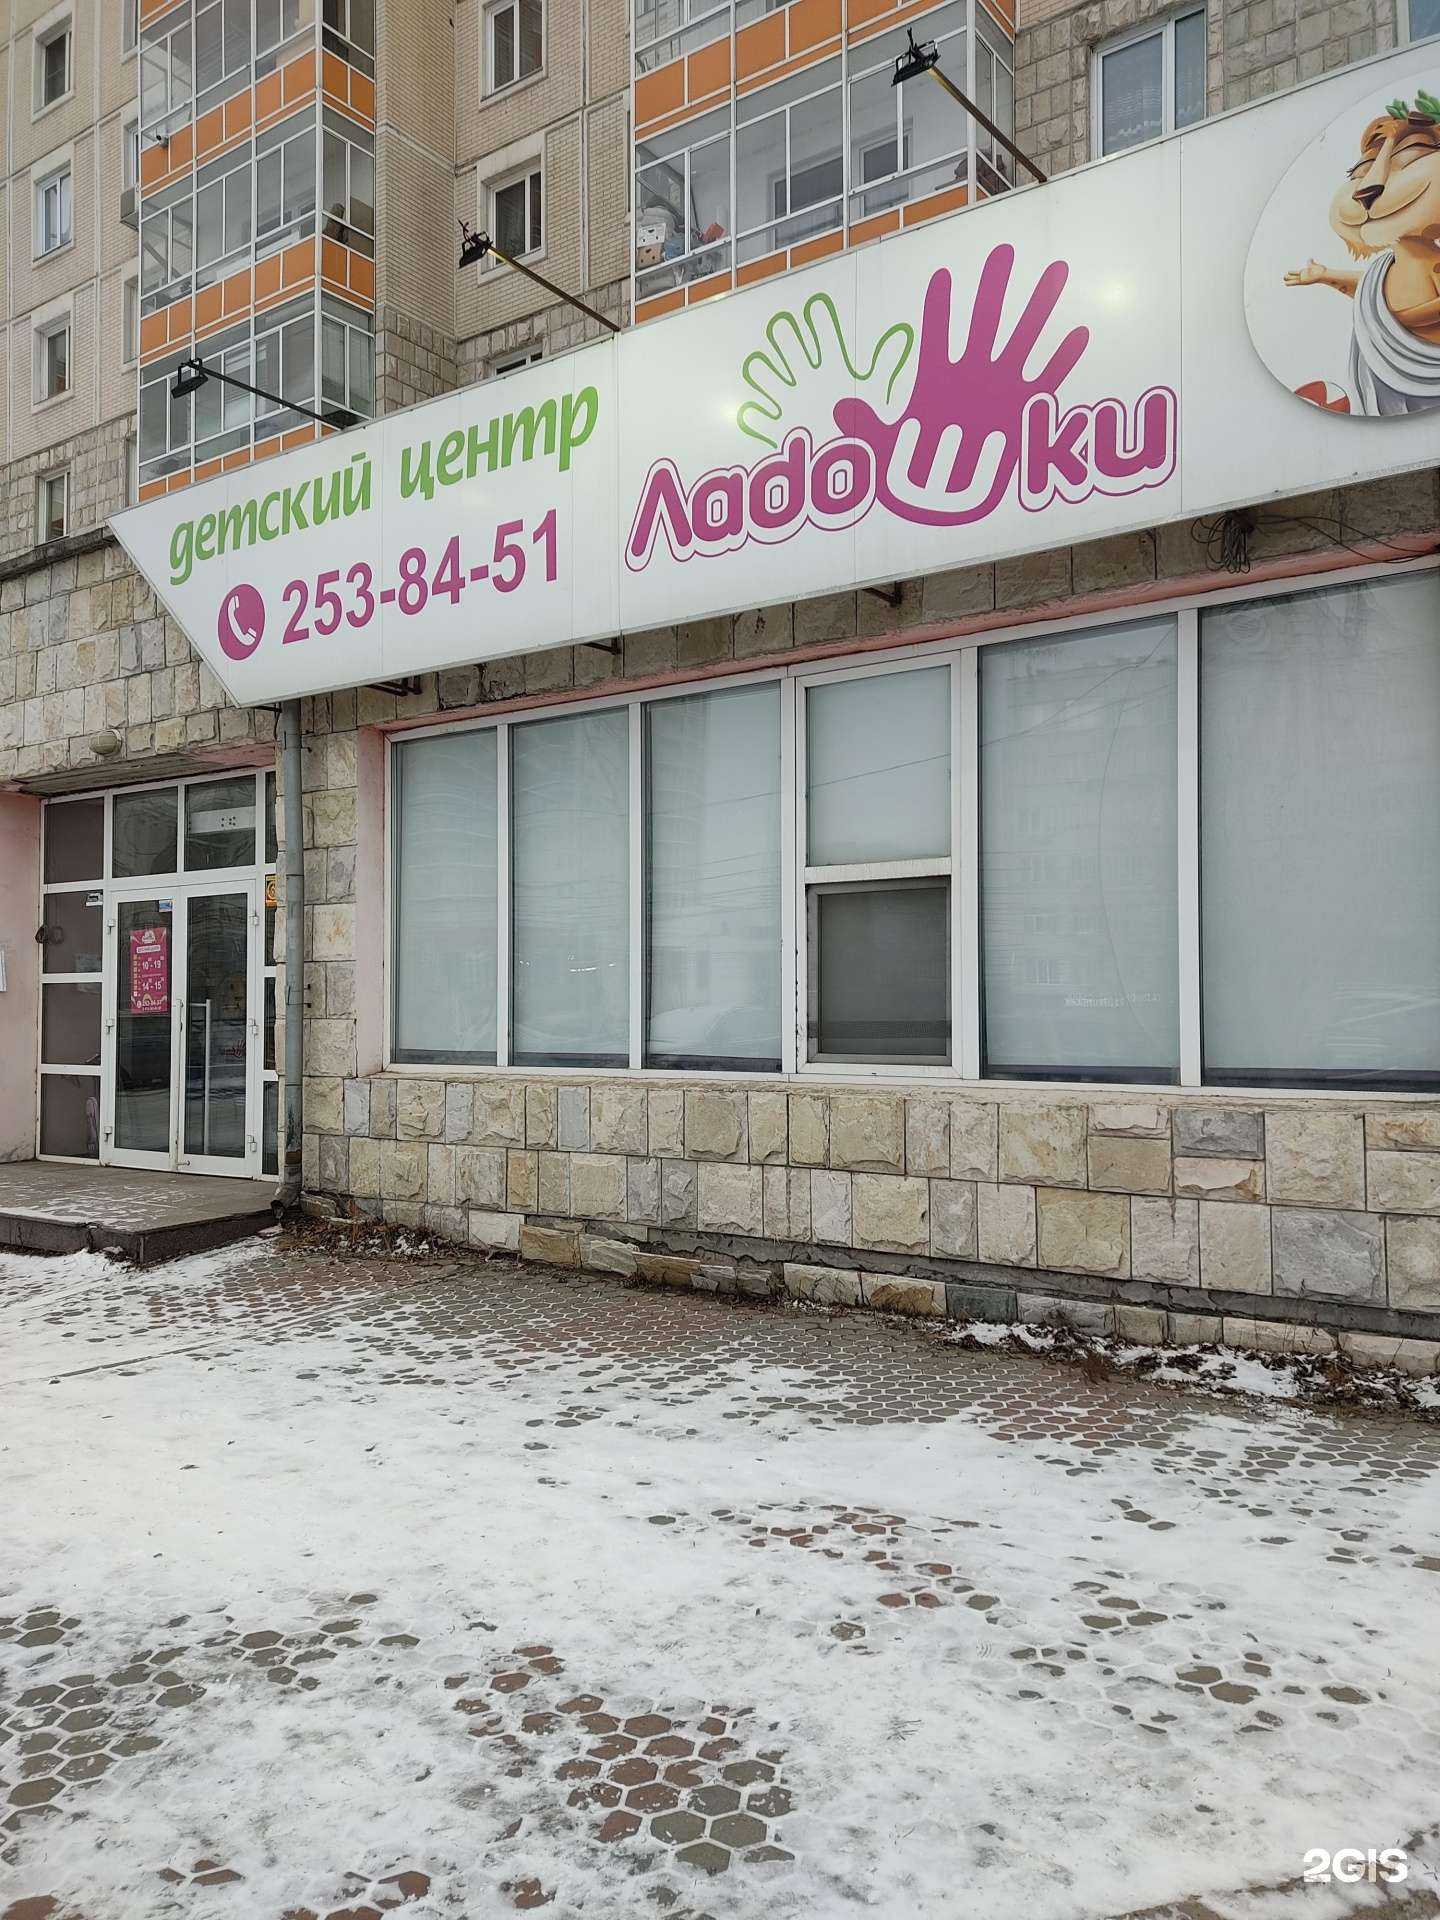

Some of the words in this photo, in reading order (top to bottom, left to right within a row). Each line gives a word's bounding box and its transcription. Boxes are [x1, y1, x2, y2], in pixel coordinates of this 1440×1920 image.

[169, 453, 373, 586] детский
[400, 385, 600, 501] центр
[627, 387, 1178, 572] Ладошки
[281, 508, 559, 646] 253-84-51
